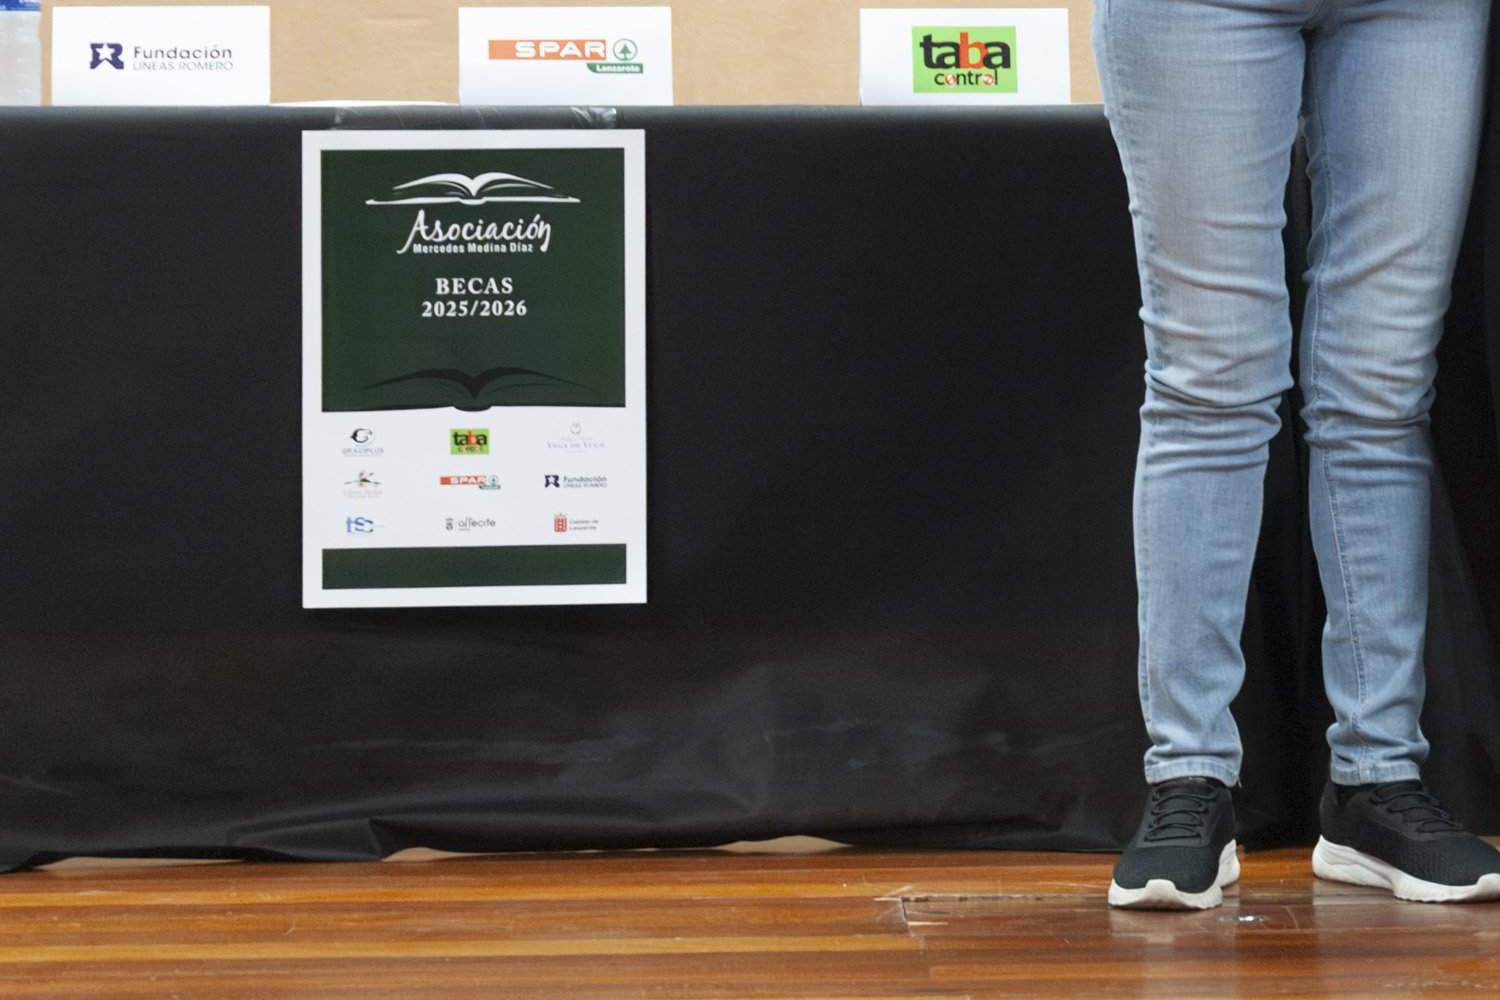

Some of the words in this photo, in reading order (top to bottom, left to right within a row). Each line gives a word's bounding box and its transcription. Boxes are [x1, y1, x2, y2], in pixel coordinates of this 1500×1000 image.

[133, 45, 233, 59] Fundación
[514, 40, 606, 59] SPAR
[919, 31, 1011, 70] taba
[178, 61, 234, 71] ROMERO
[934, 69, 998, 86] control
[396, 209, 552, 254] Asociación
[413, 243, 465, 254] Mercedes
[467, 242, 509, 253] Medina
[435, 277, 514, 295] BECAS
[422, 301, 528, 317] 2025/2026
